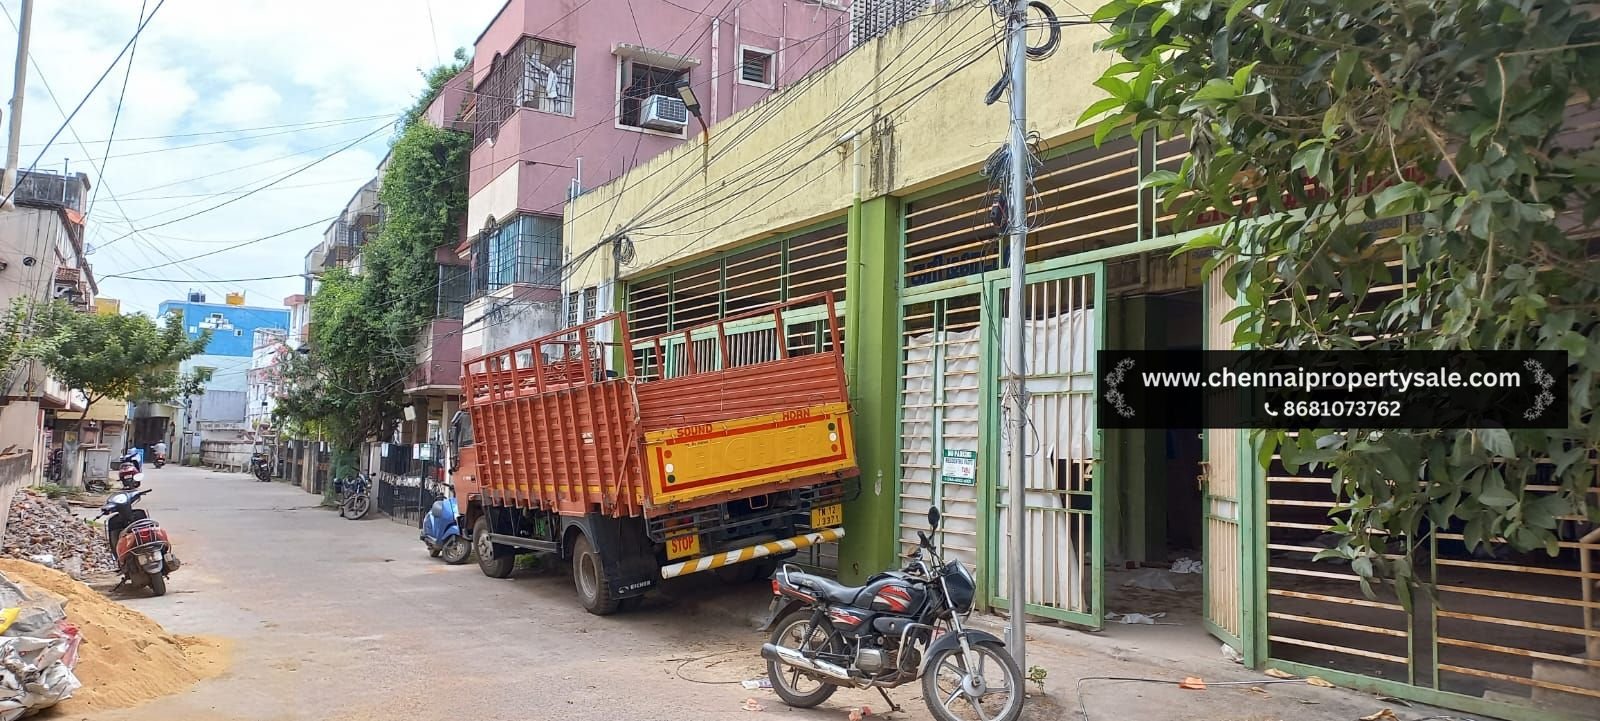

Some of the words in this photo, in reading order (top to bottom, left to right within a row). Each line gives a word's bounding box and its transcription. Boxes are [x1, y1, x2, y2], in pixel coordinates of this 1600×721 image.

[782, 409, 810, 420] HORN
[676, 424, 712, 437] SOUND
[672, 535, 694, 554] STOP
[630, 580, 651, 590] EICHER
